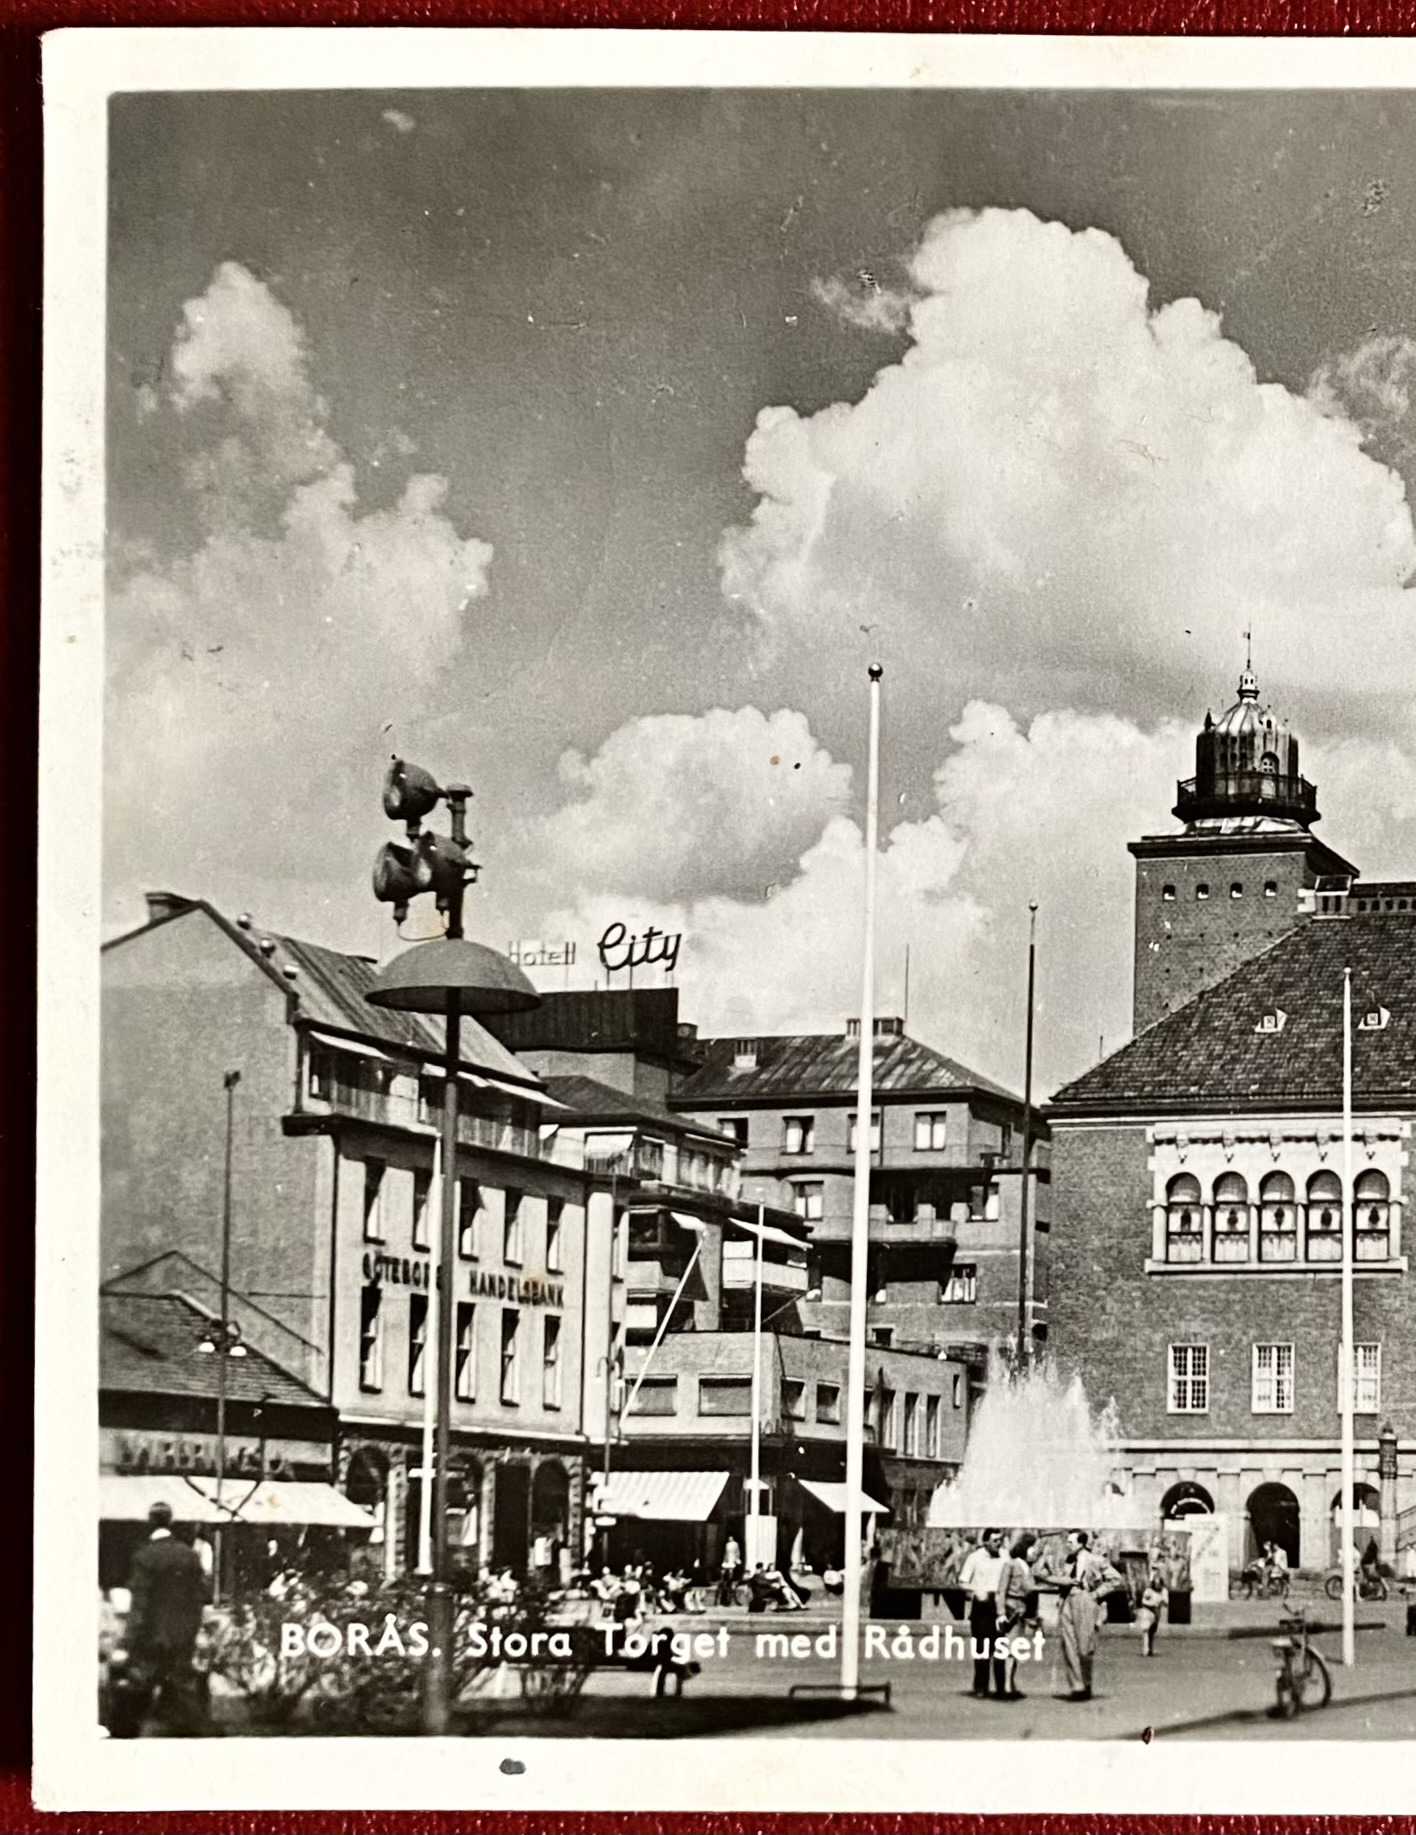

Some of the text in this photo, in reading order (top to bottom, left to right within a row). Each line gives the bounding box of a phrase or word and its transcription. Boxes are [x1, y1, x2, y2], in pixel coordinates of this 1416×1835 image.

[509, 922, 682, 973] Hotell City
[469, 1270, 565, 1309] HANDELSBANK
